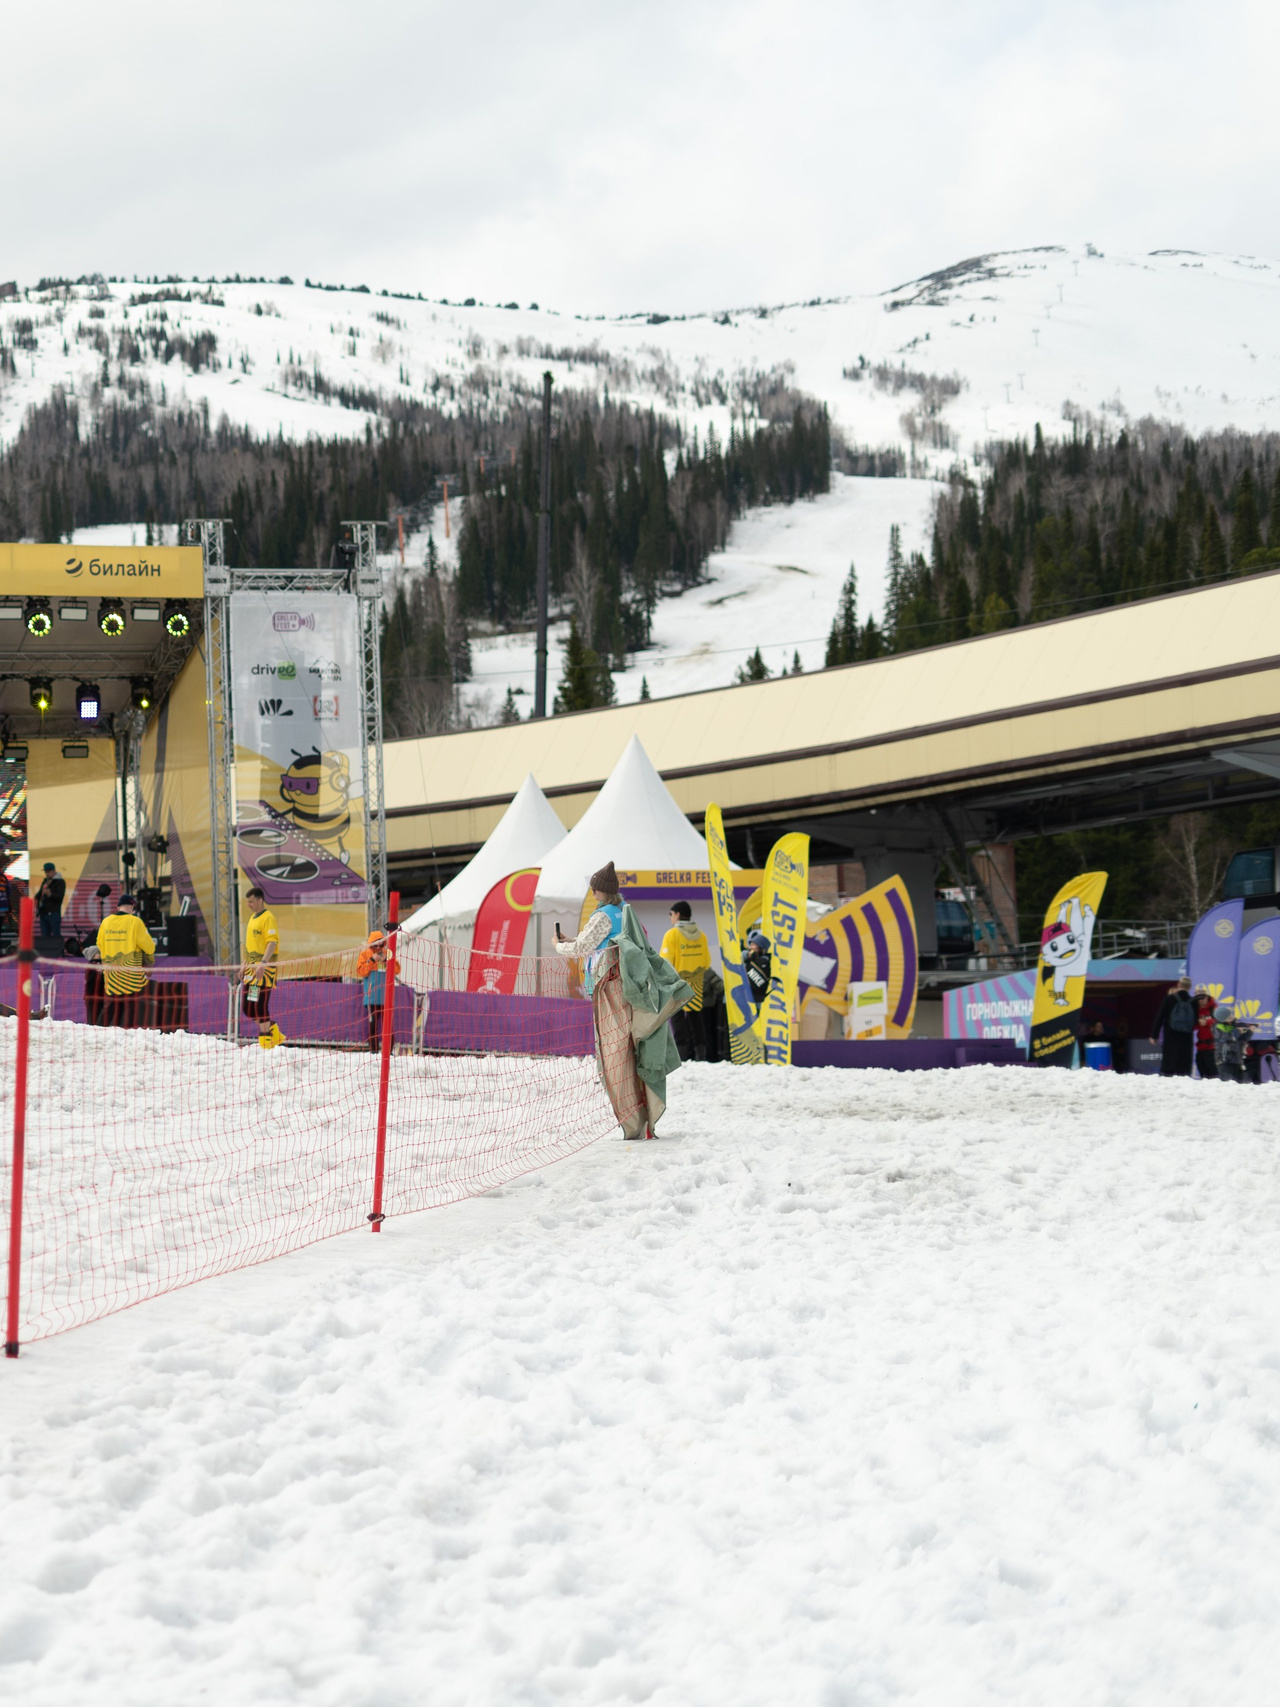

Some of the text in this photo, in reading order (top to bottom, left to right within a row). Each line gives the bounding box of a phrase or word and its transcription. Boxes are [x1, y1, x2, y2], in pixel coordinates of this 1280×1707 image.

[89, 558, 161, 577] билайн
[656, 872, 692, 884] GRELKA
[747, 967, 765, 987] NIKE
[966, 999, 1034, 1020] ГОРНОЛЫЖНА
